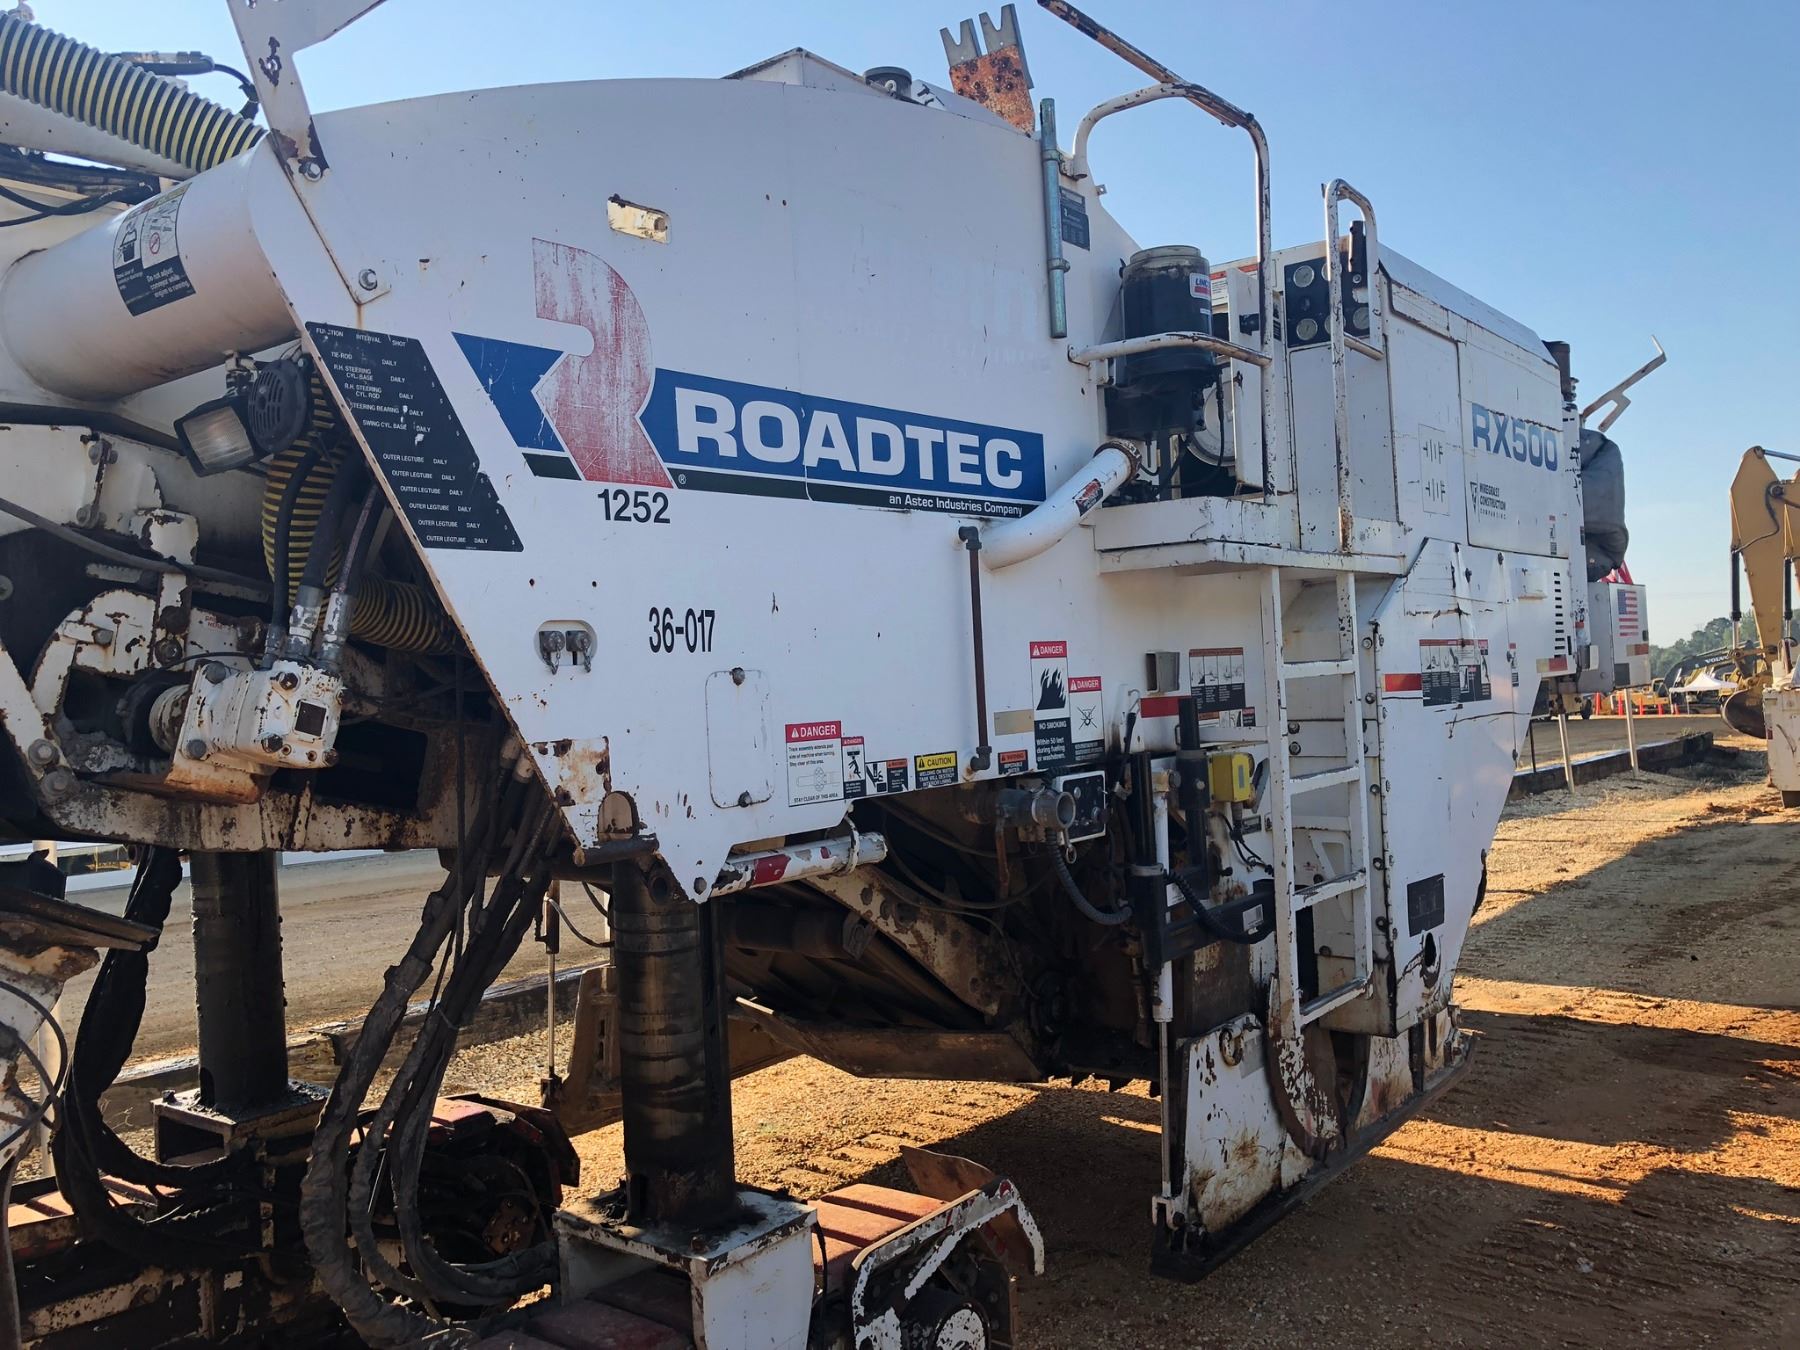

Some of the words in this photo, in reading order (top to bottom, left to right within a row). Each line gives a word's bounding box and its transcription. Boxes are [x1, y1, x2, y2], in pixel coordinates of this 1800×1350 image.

[331, 352, 352, 360] TIE-ROD
[345, 365, 371, 374] STEERING
[356, 385, 382, 393] STEERING
[377, 405, 399, 414] BEARING
[393, 423, 407, 431] BASE
[416, 425, 431, 433] DAILY
[675, 387, 1023, 490] ROADTEC
[1471, 402, 1558, 472] RX500
[383, 453, 401, 461] OUTER
[401, 455, 424, 463] LEGTUBE
[597, 489, 671, 524] 1252
[889, 495, 901, 504] an
[905, 494, 933, 507] Astec
[937, 497, 982, 512] Industries
[984, 502, 1022, 517] Company
[649, 607, 716, 653] 36-017
[1040, 646, 1063, 655] DANGER
[1705, 655, 1729, 664] VOLVO
[1077, 680, 1099, 688] DANGER
[1047, 721, 1067, 729] SMOKING
[800, 725, 836, 737] DANGER
[1037, 746, 1050, 754] during
[1051, 745, 1065, 753] fueling
[927, 757, 952, 767] CAUTION
